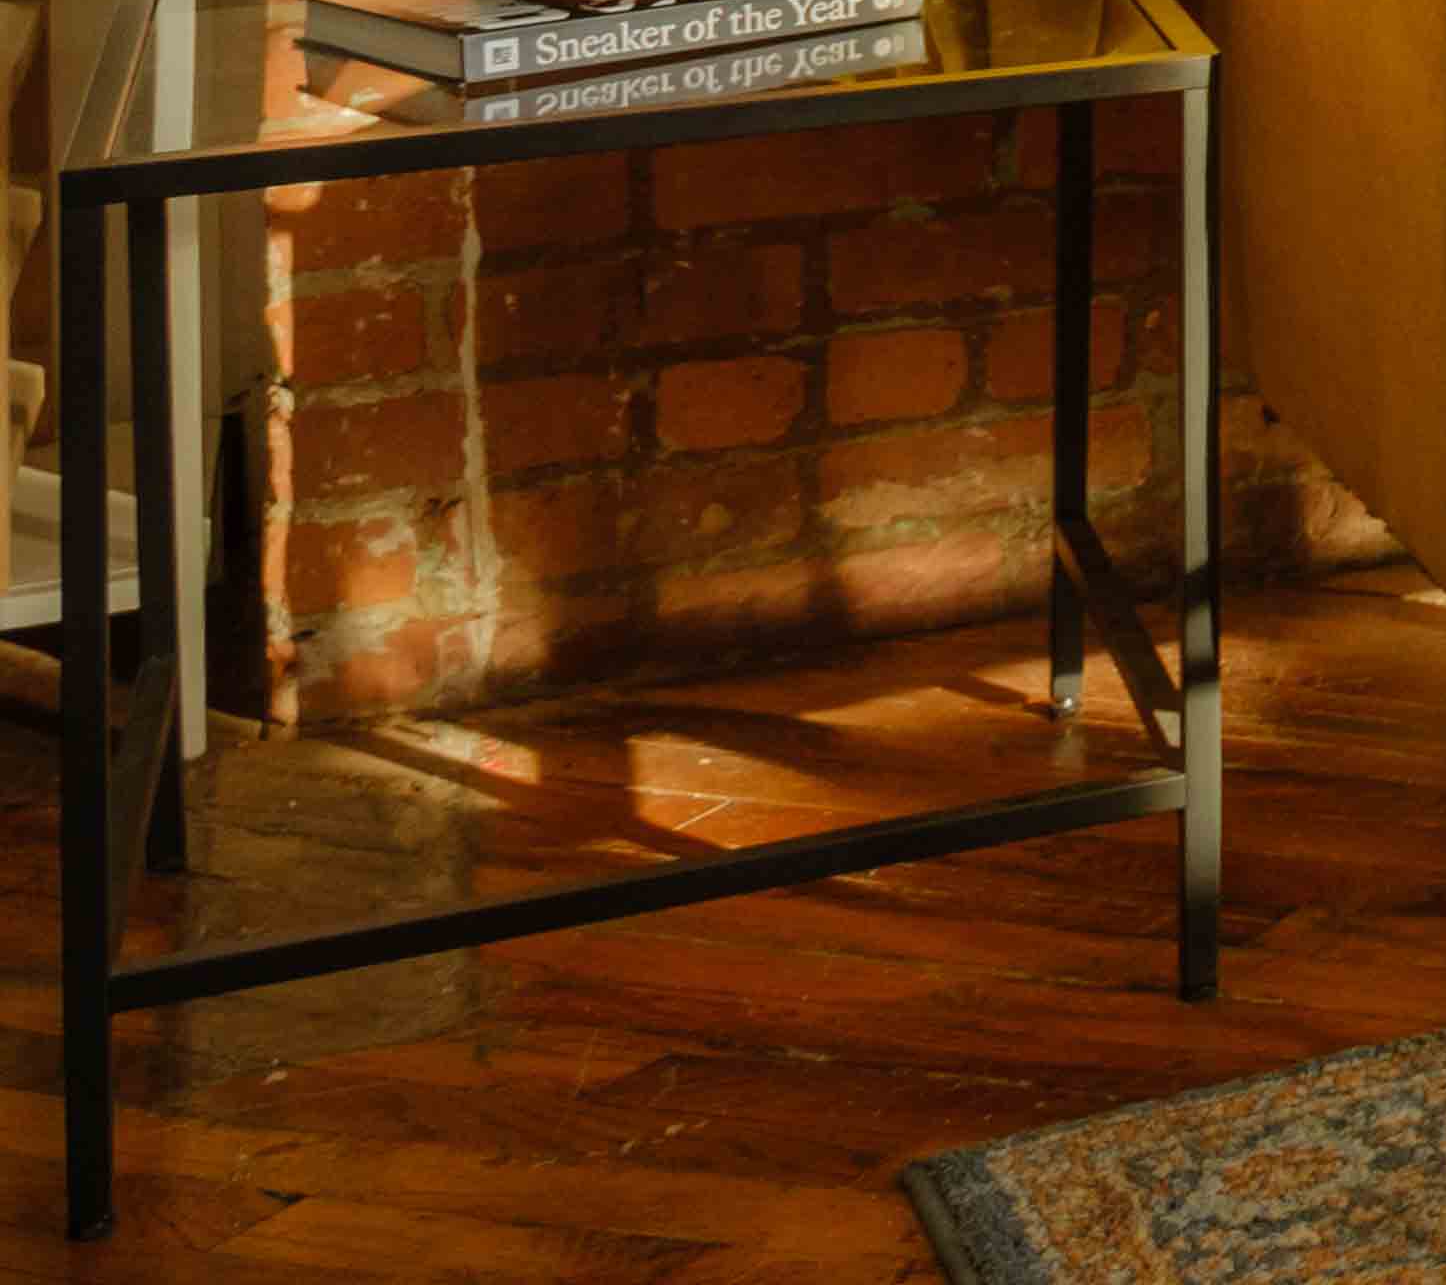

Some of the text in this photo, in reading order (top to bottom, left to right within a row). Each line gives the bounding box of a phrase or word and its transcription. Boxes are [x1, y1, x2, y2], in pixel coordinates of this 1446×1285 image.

[535, 23, 675, 66] Sneaker
[682, 10, 724, 46] of
[730, 3, 784, 37] the
